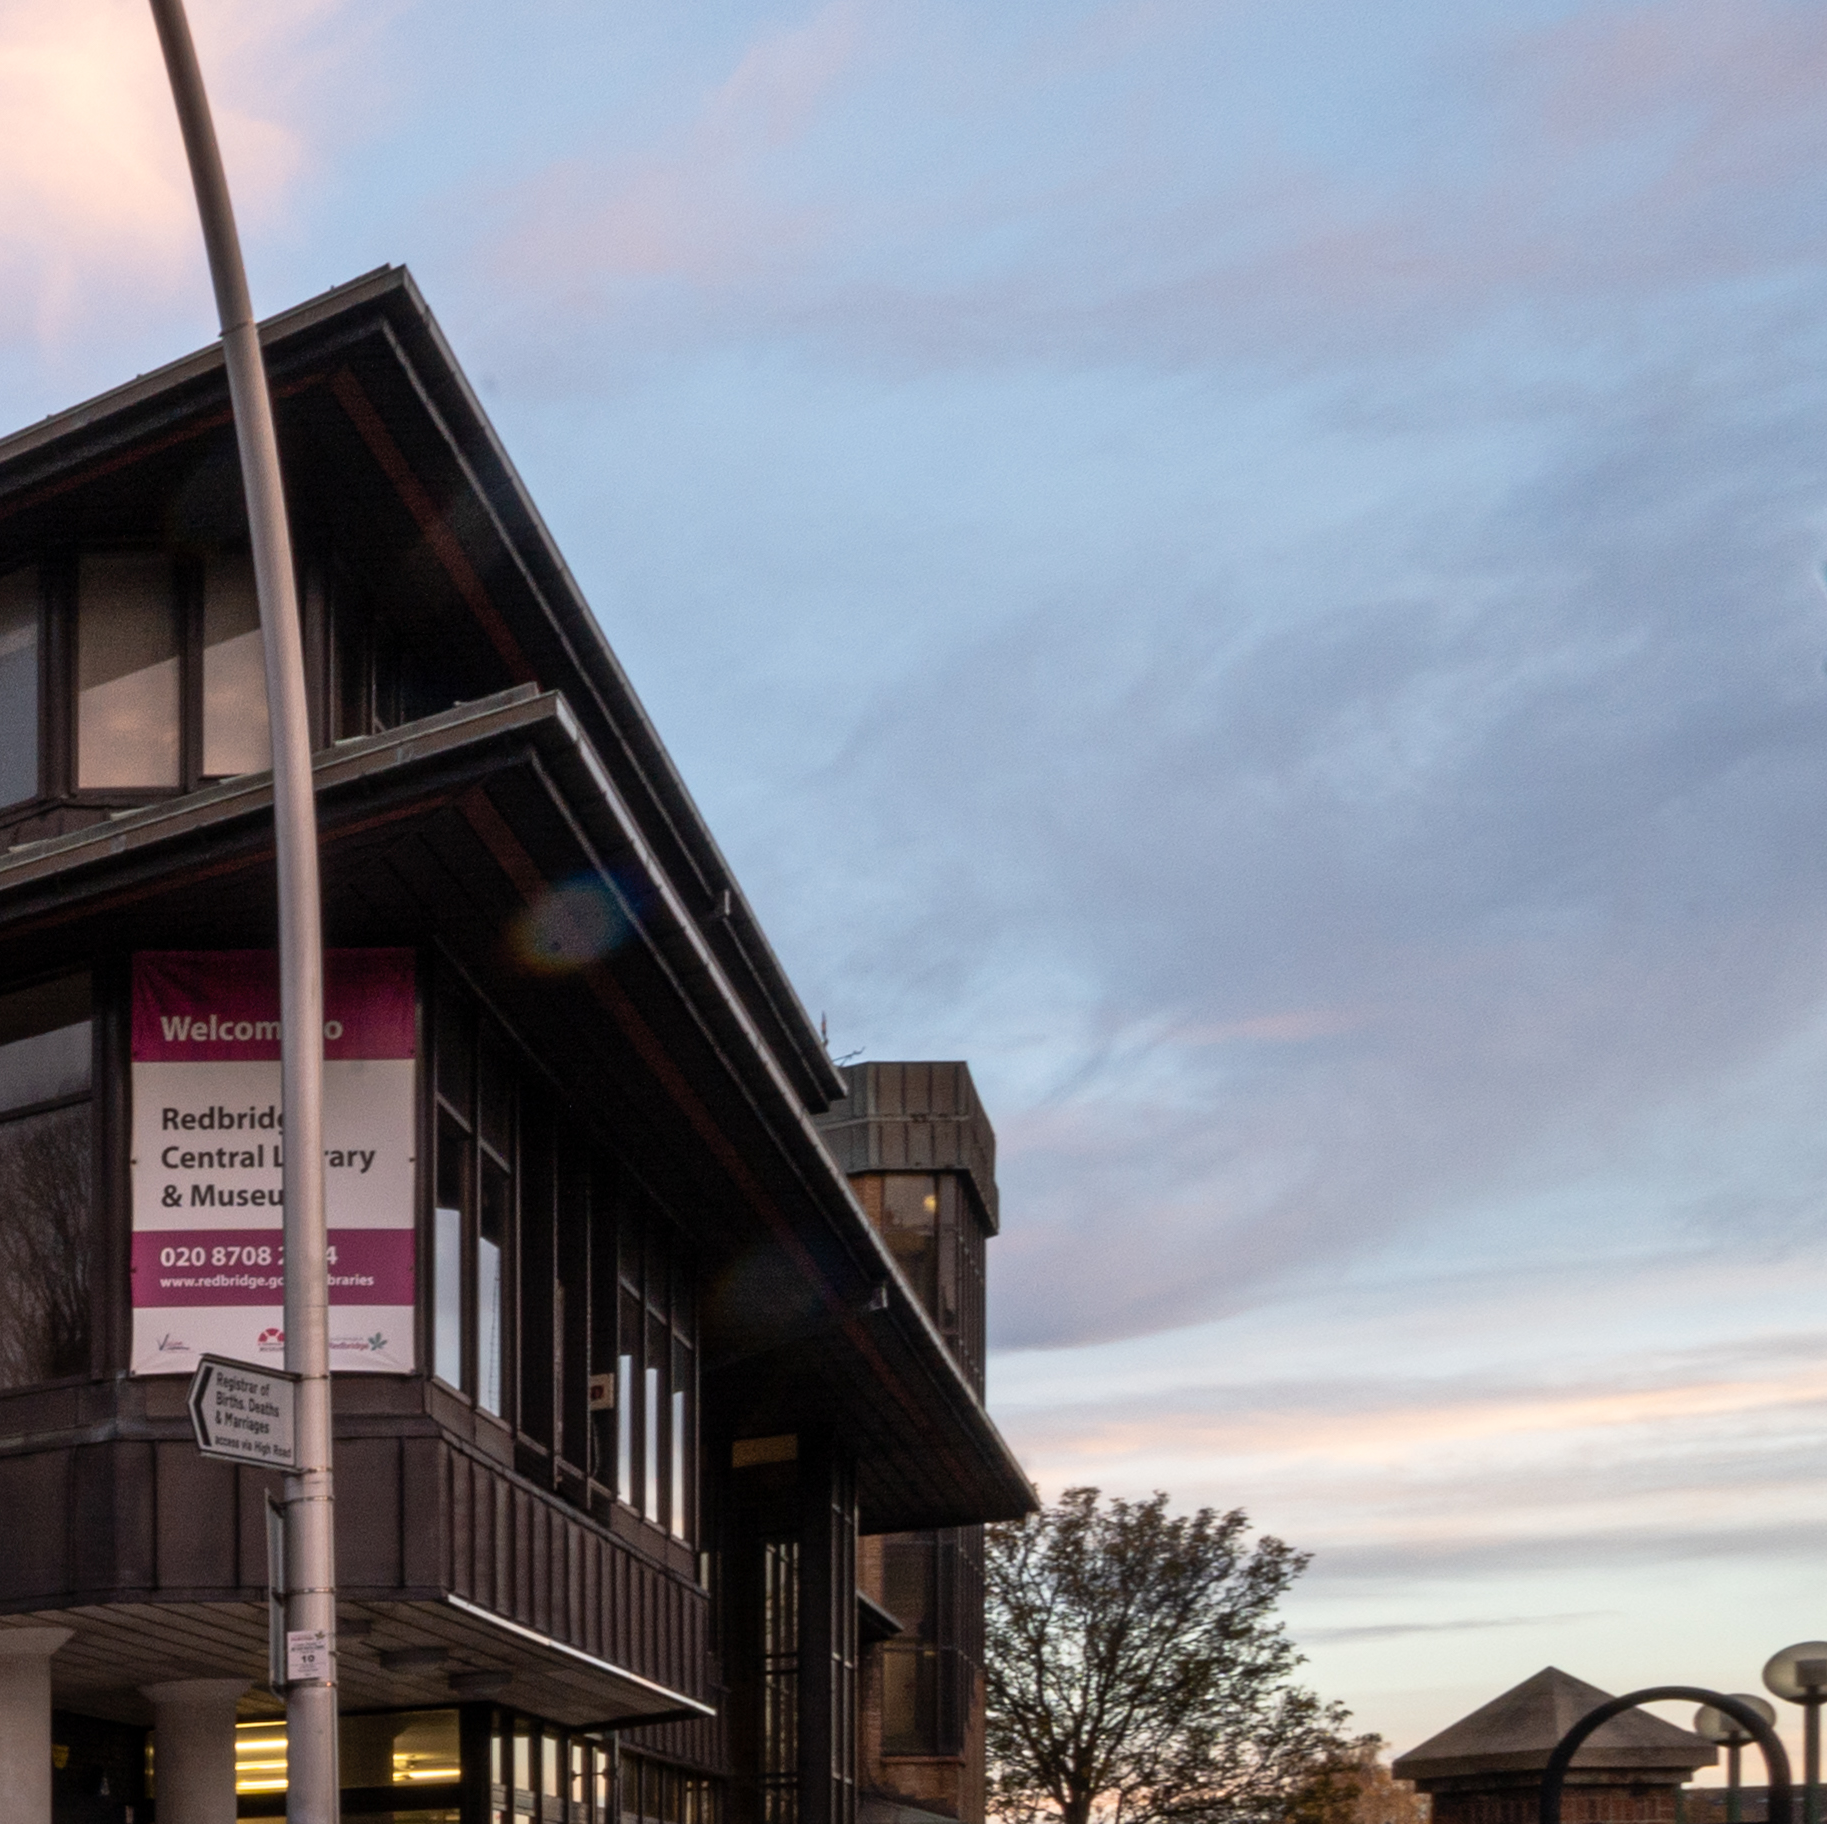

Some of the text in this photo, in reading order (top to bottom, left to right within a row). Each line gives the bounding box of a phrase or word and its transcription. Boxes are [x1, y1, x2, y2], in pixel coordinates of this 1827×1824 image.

[160, 1015, 283, 1042] Welcom
[161, 1106, 283, 1134] Redbrid
[161, 1145, 264, 1170] Central
[161, 1184, 284, 1208] & Museu
[159, 1244, 339, 1267] 020 8708 24
[216, 1372, 270, 1396] Registrar of
[248, 1398, 280, 1418] Deaths
[215, 1410, 270, 1435] & Marriages
[254, 1441, 272, 1457] High
[273, 1444, 292, 1458] Road
[301, 1654, 315, 1663] 10
